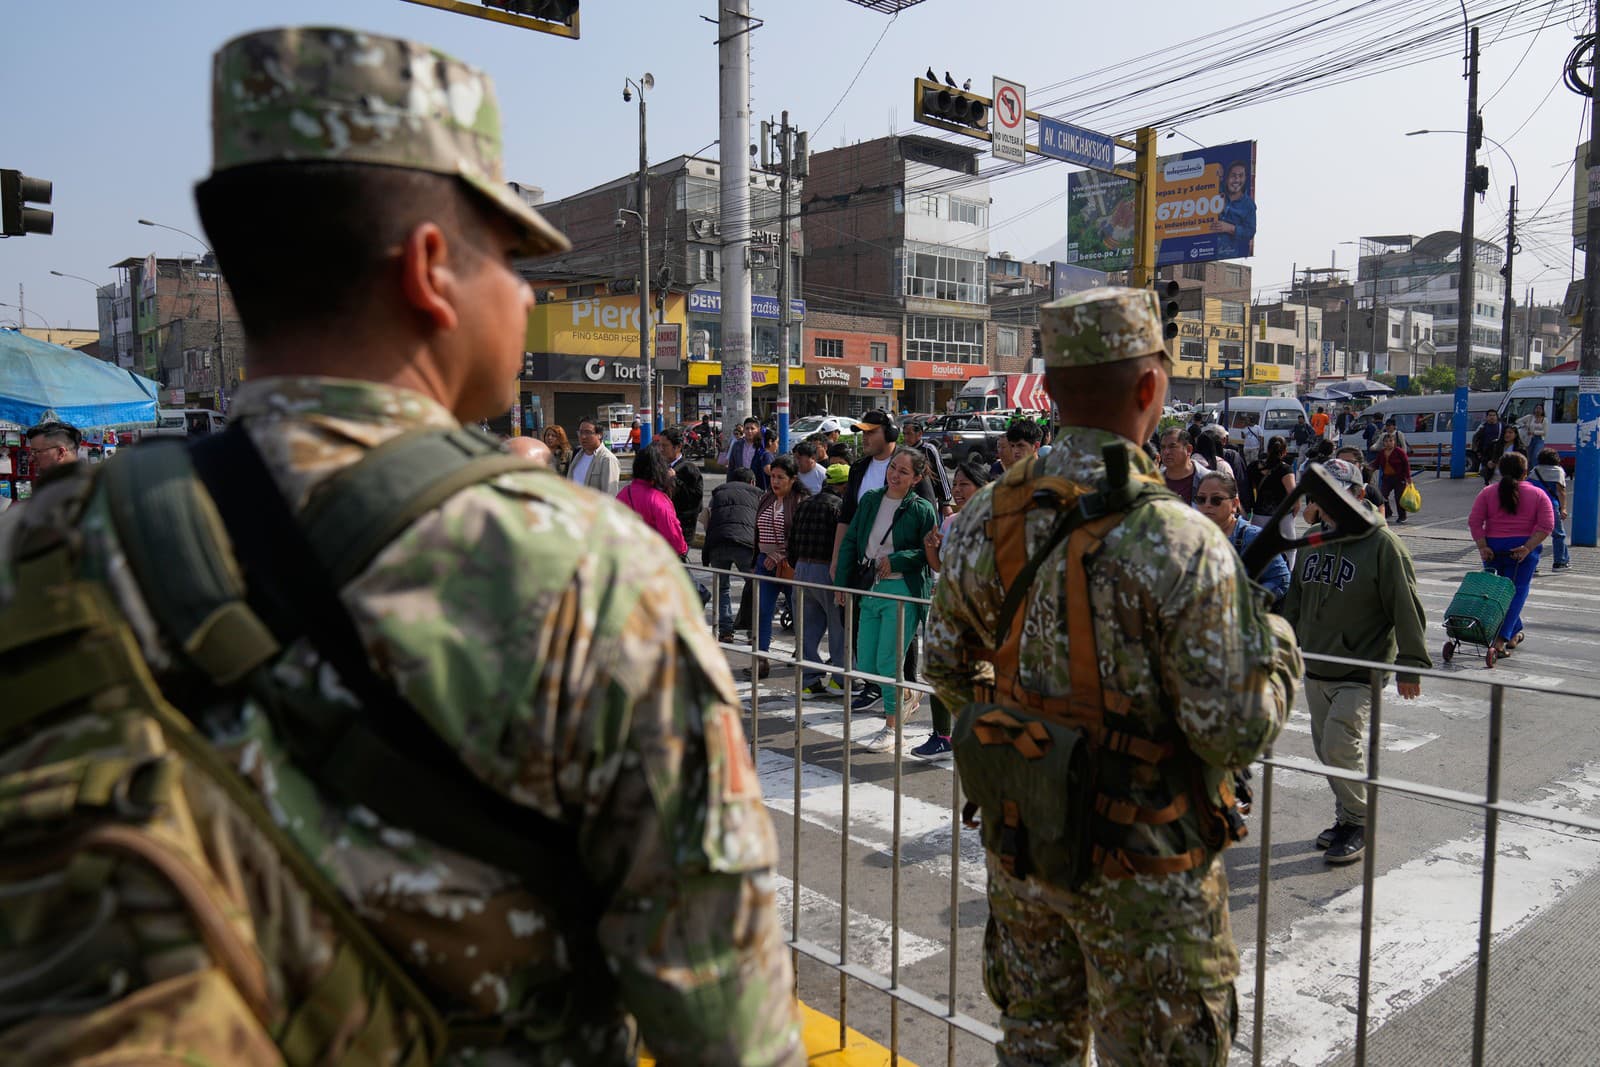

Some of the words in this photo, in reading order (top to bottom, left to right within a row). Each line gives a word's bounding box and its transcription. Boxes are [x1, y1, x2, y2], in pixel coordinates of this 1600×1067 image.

[1044, 127, 1056, 148] AV.
[1058, 130, 1111, 163] CHINCHAYSUYO
[572, 331, 591, 340] FINO
[593, 333, 619, 341] SABOR
[1302, 552, 1356, 592] GAP
